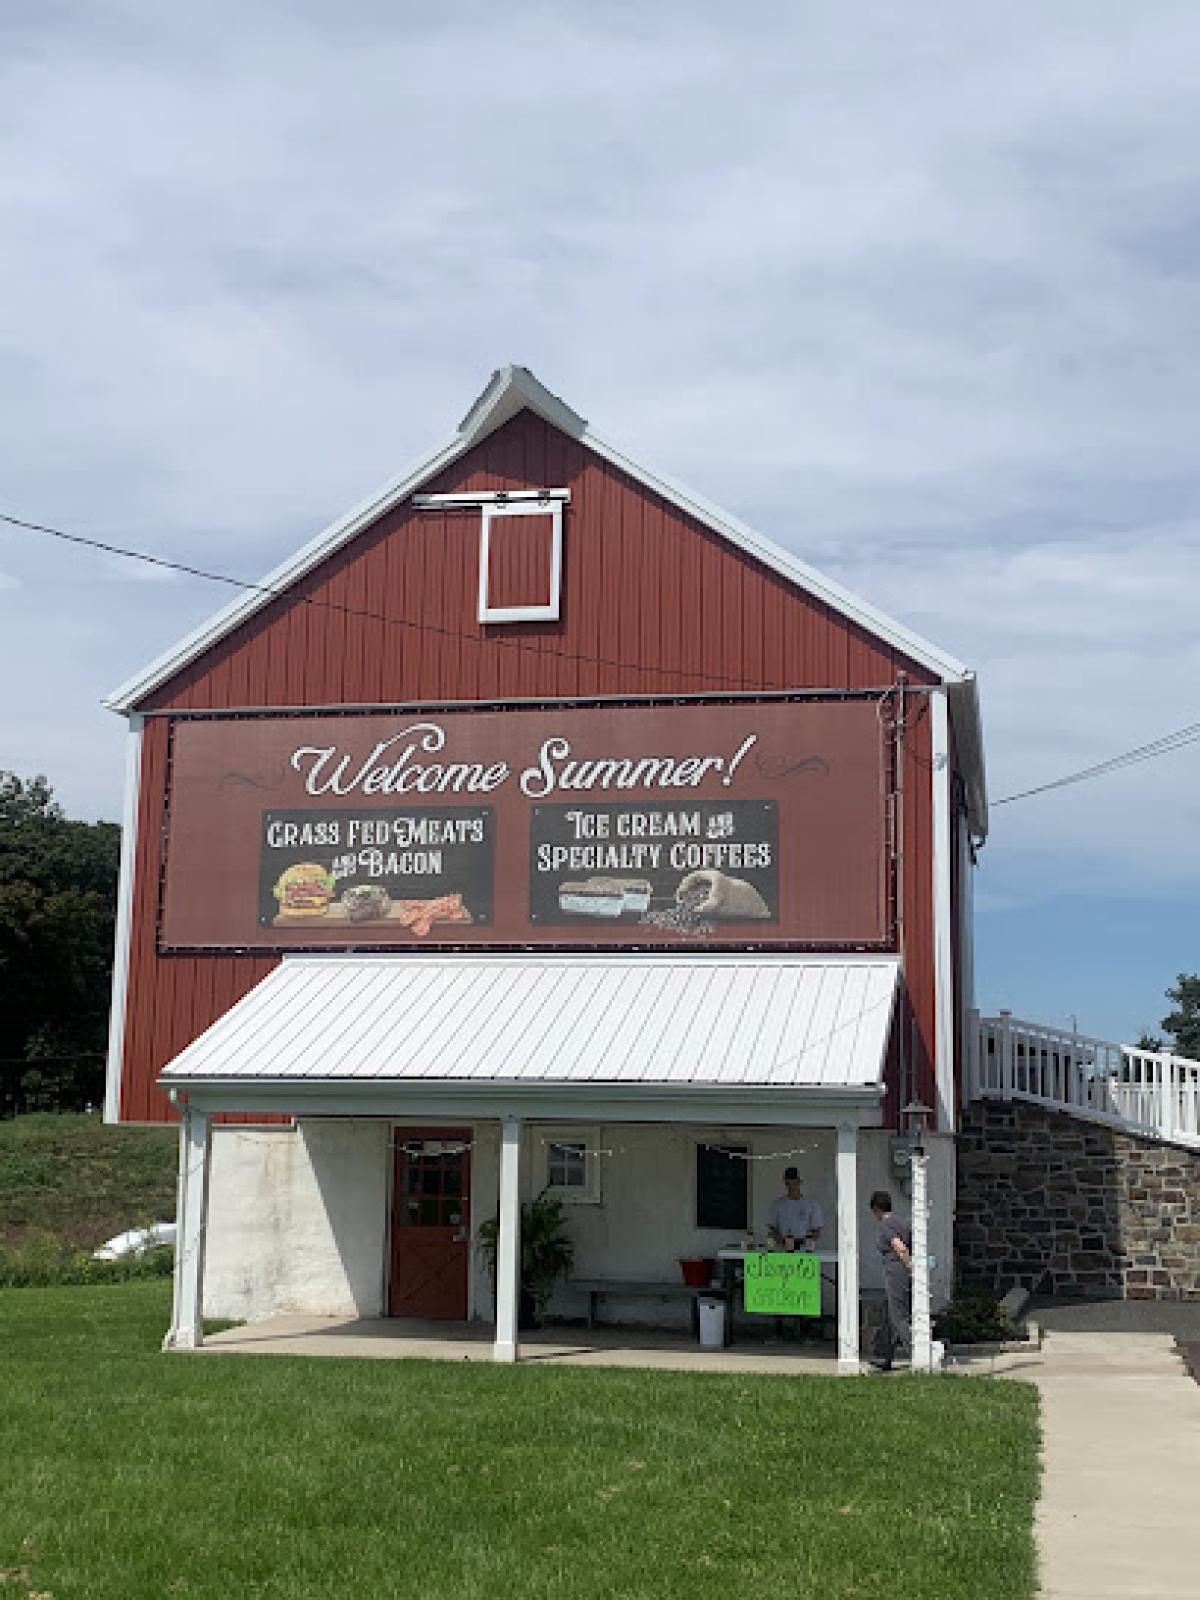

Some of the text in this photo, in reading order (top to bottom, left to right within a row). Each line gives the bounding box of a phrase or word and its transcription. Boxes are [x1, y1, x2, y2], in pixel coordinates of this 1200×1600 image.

[290, 722, 757, 798] Welcome Summer!
[266, 817, 484, 848] GRASS FED MEATS
[564, 811, 610, 839] ICE
[616, 811, 701, 838] CREAM
[358, 846, 443, 878] BACON
[536, 842, 772, 872] SPECIALTY COFFEES
